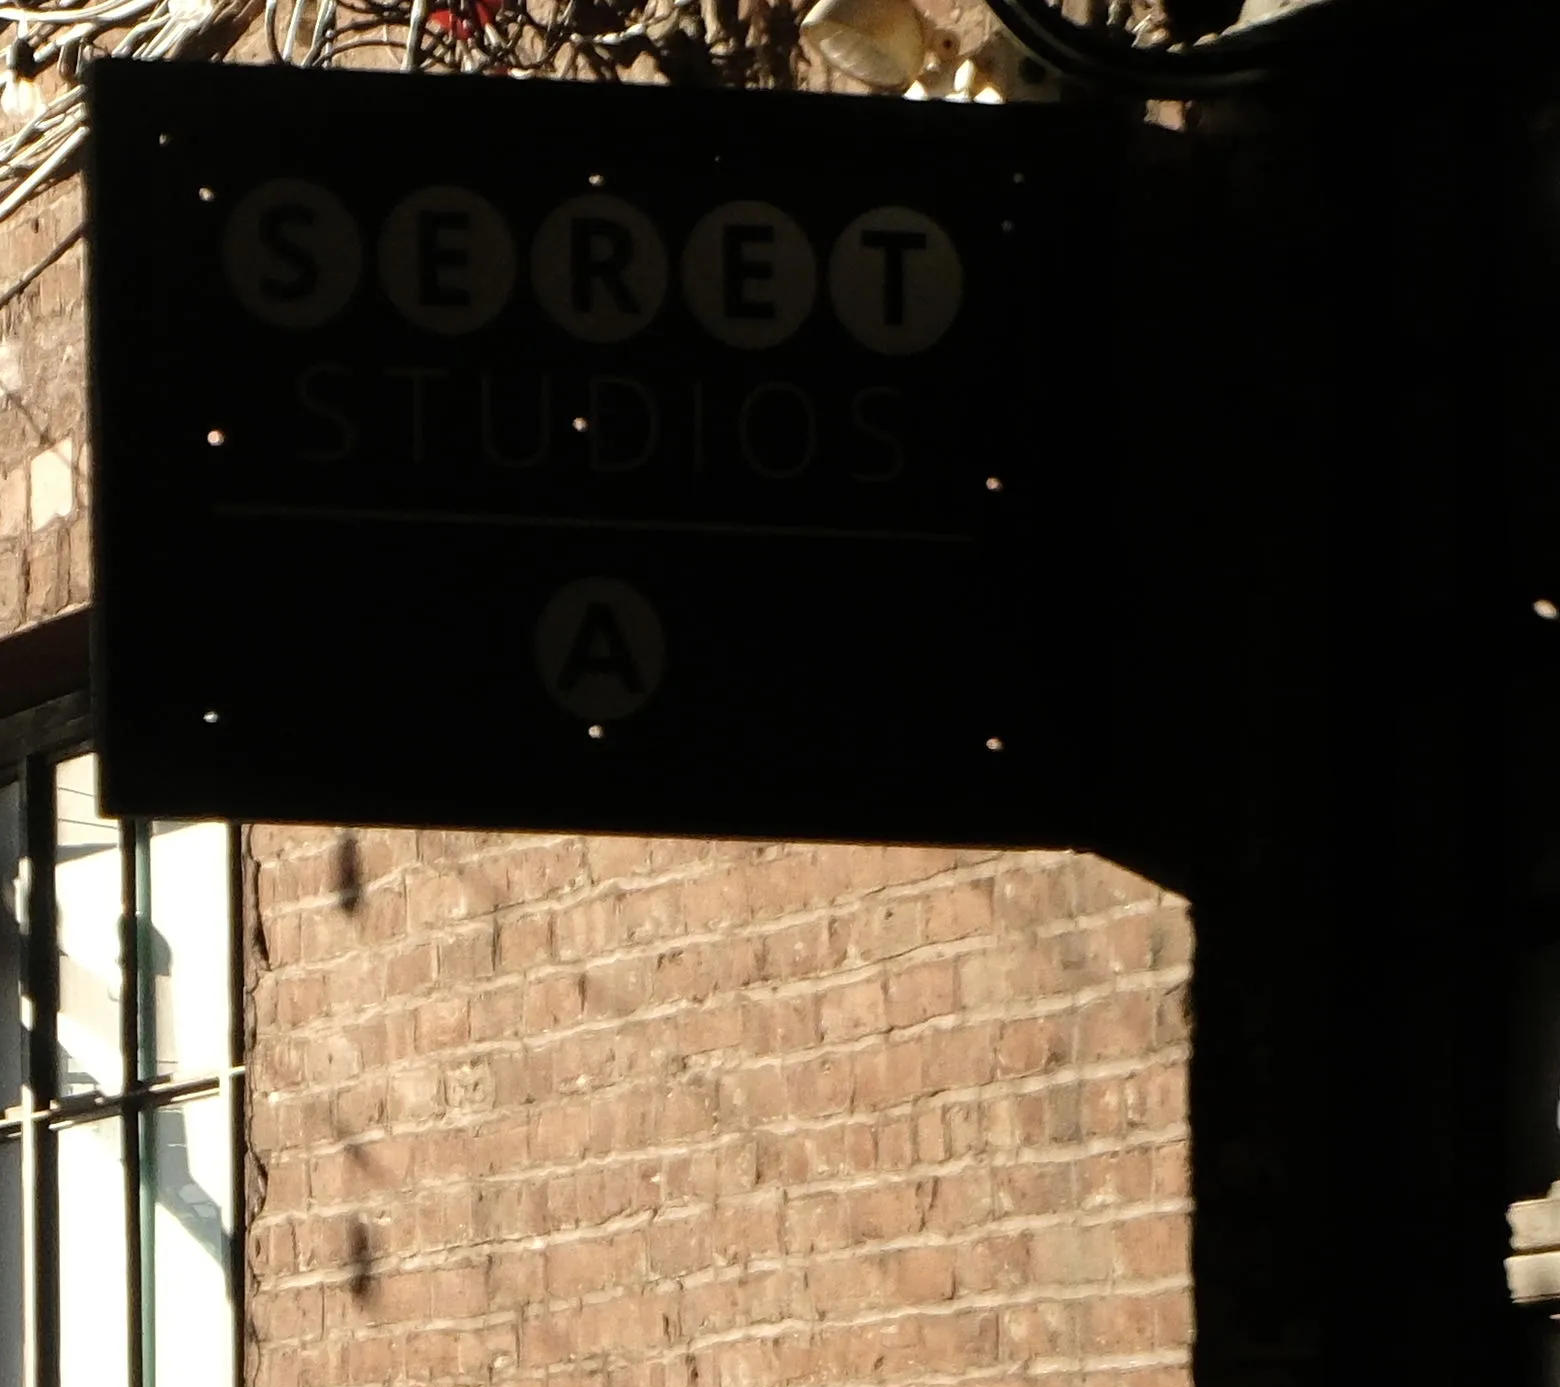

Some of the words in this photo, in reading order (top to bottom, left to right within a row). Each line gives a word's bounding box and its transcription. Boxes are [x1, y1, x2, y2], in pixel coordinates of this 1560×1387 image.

[254, 196, 932, 334] SERET
[293, 362, 909, 485] STUDIOS
[550, 594, 652, 702] A
